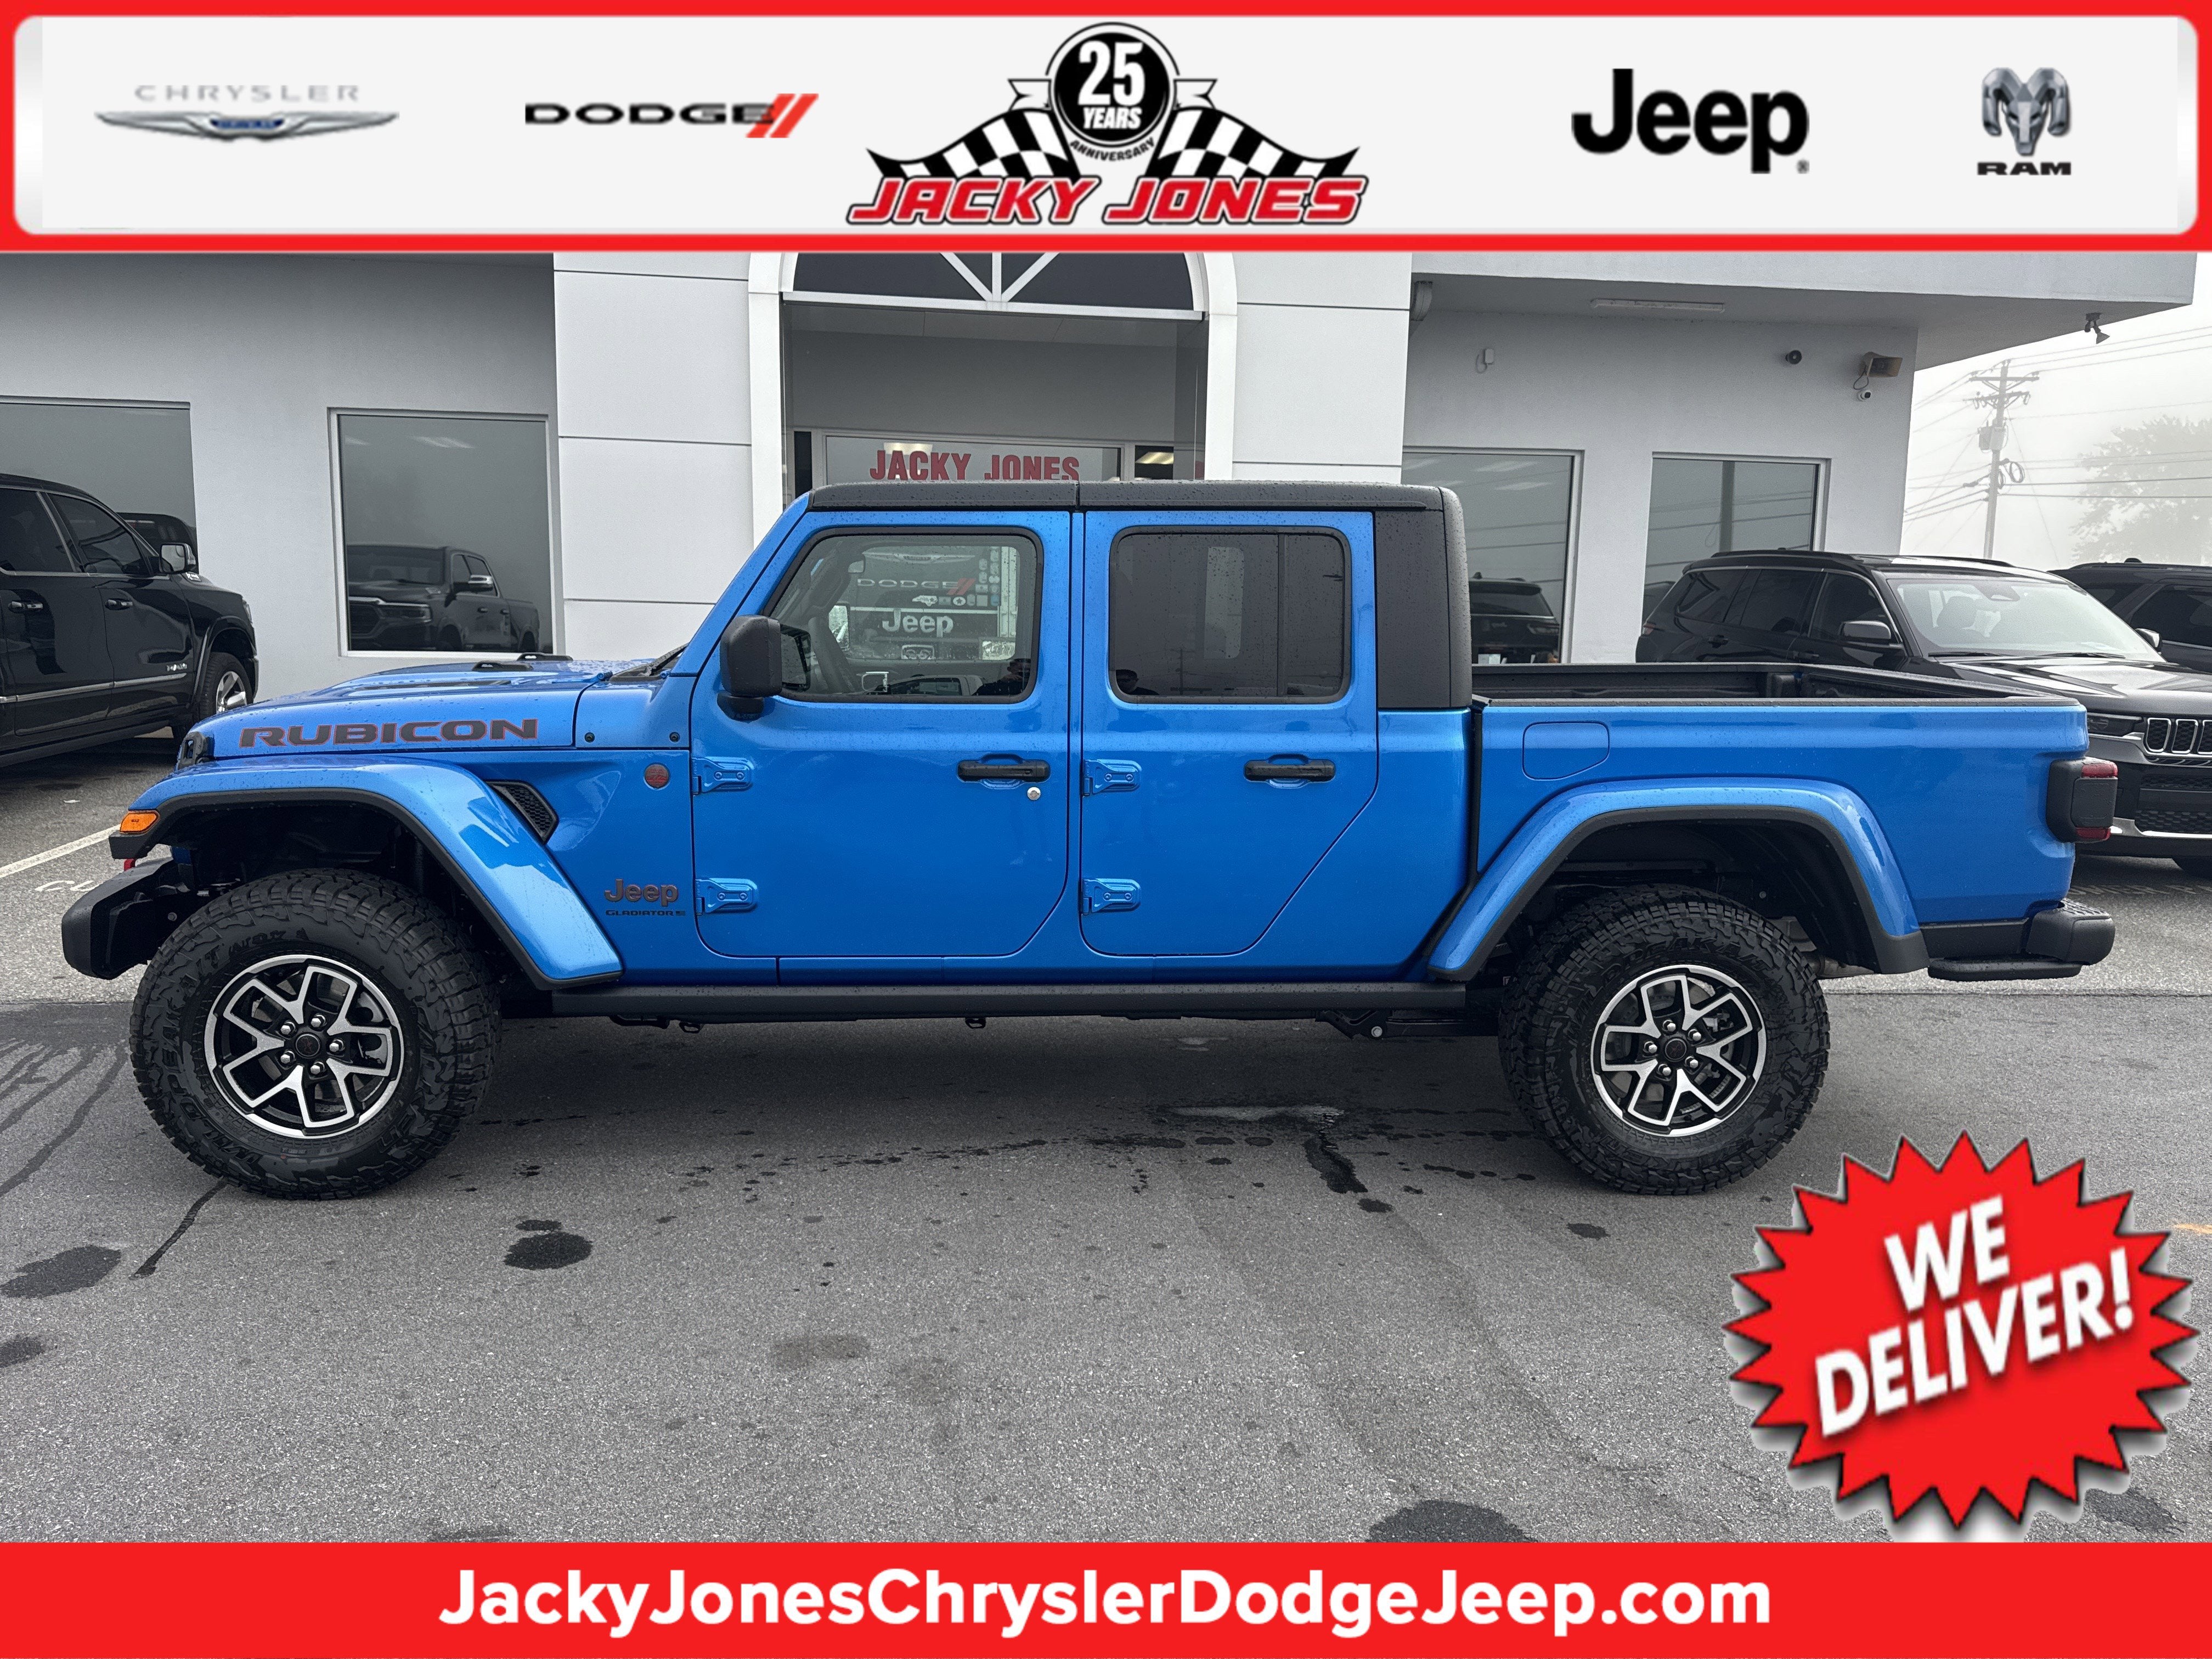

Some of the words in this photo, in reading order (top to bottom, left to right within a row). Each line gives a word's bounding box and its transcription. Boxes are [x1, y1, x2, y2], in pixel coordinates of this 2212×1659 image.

[870, 450, 972, 480] JACKY
[984, 454, 1080, 480] JONES
[857, 579, 960, 589] DODGE
[882, 608, 953, 637] Jeep
[239, 718, 538, 748] RUBICON
[605, 878, 679, 907] Jeep
